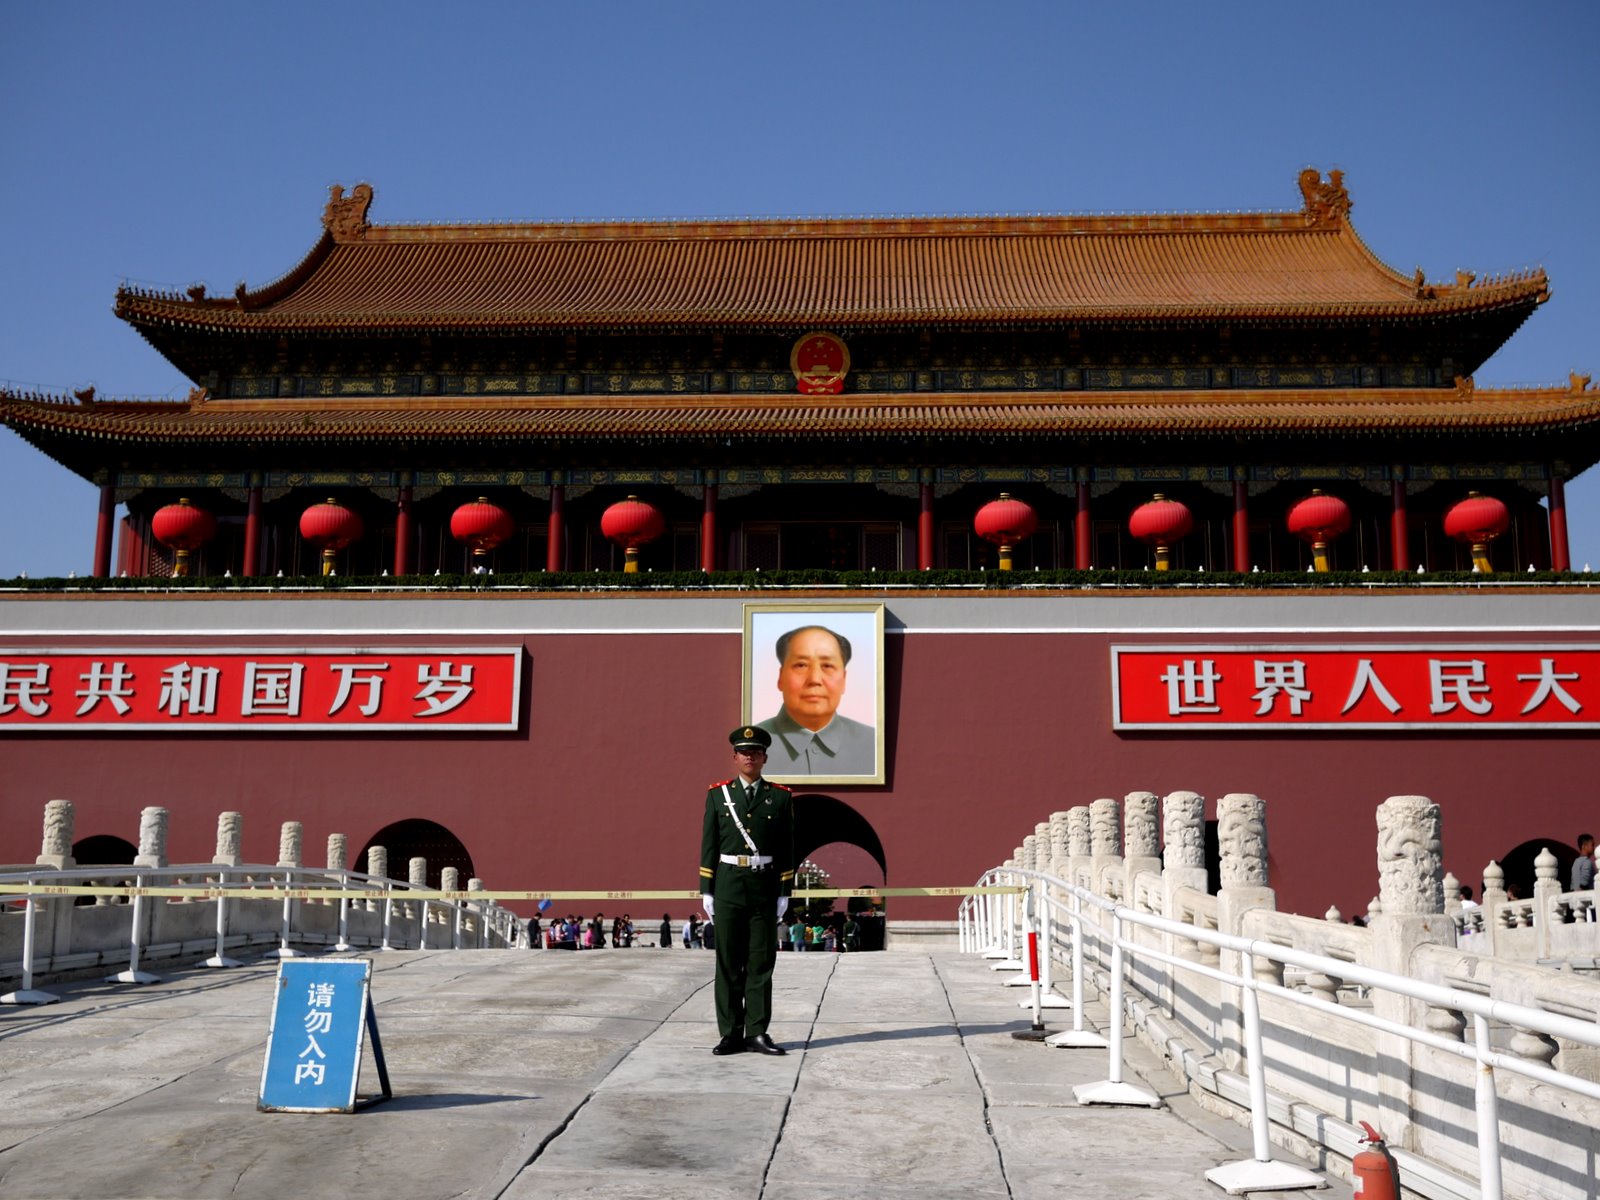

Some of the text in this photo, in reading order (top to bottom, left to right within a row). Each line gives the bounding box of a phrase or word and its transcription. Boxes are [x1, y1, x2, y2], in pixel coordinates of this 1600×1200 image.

[0, 661, 475, 717] 民共和国万岁
[1160, 658, 1583, 716] 世界人民大
[294, 982, 335, 1086] 请勿入内
